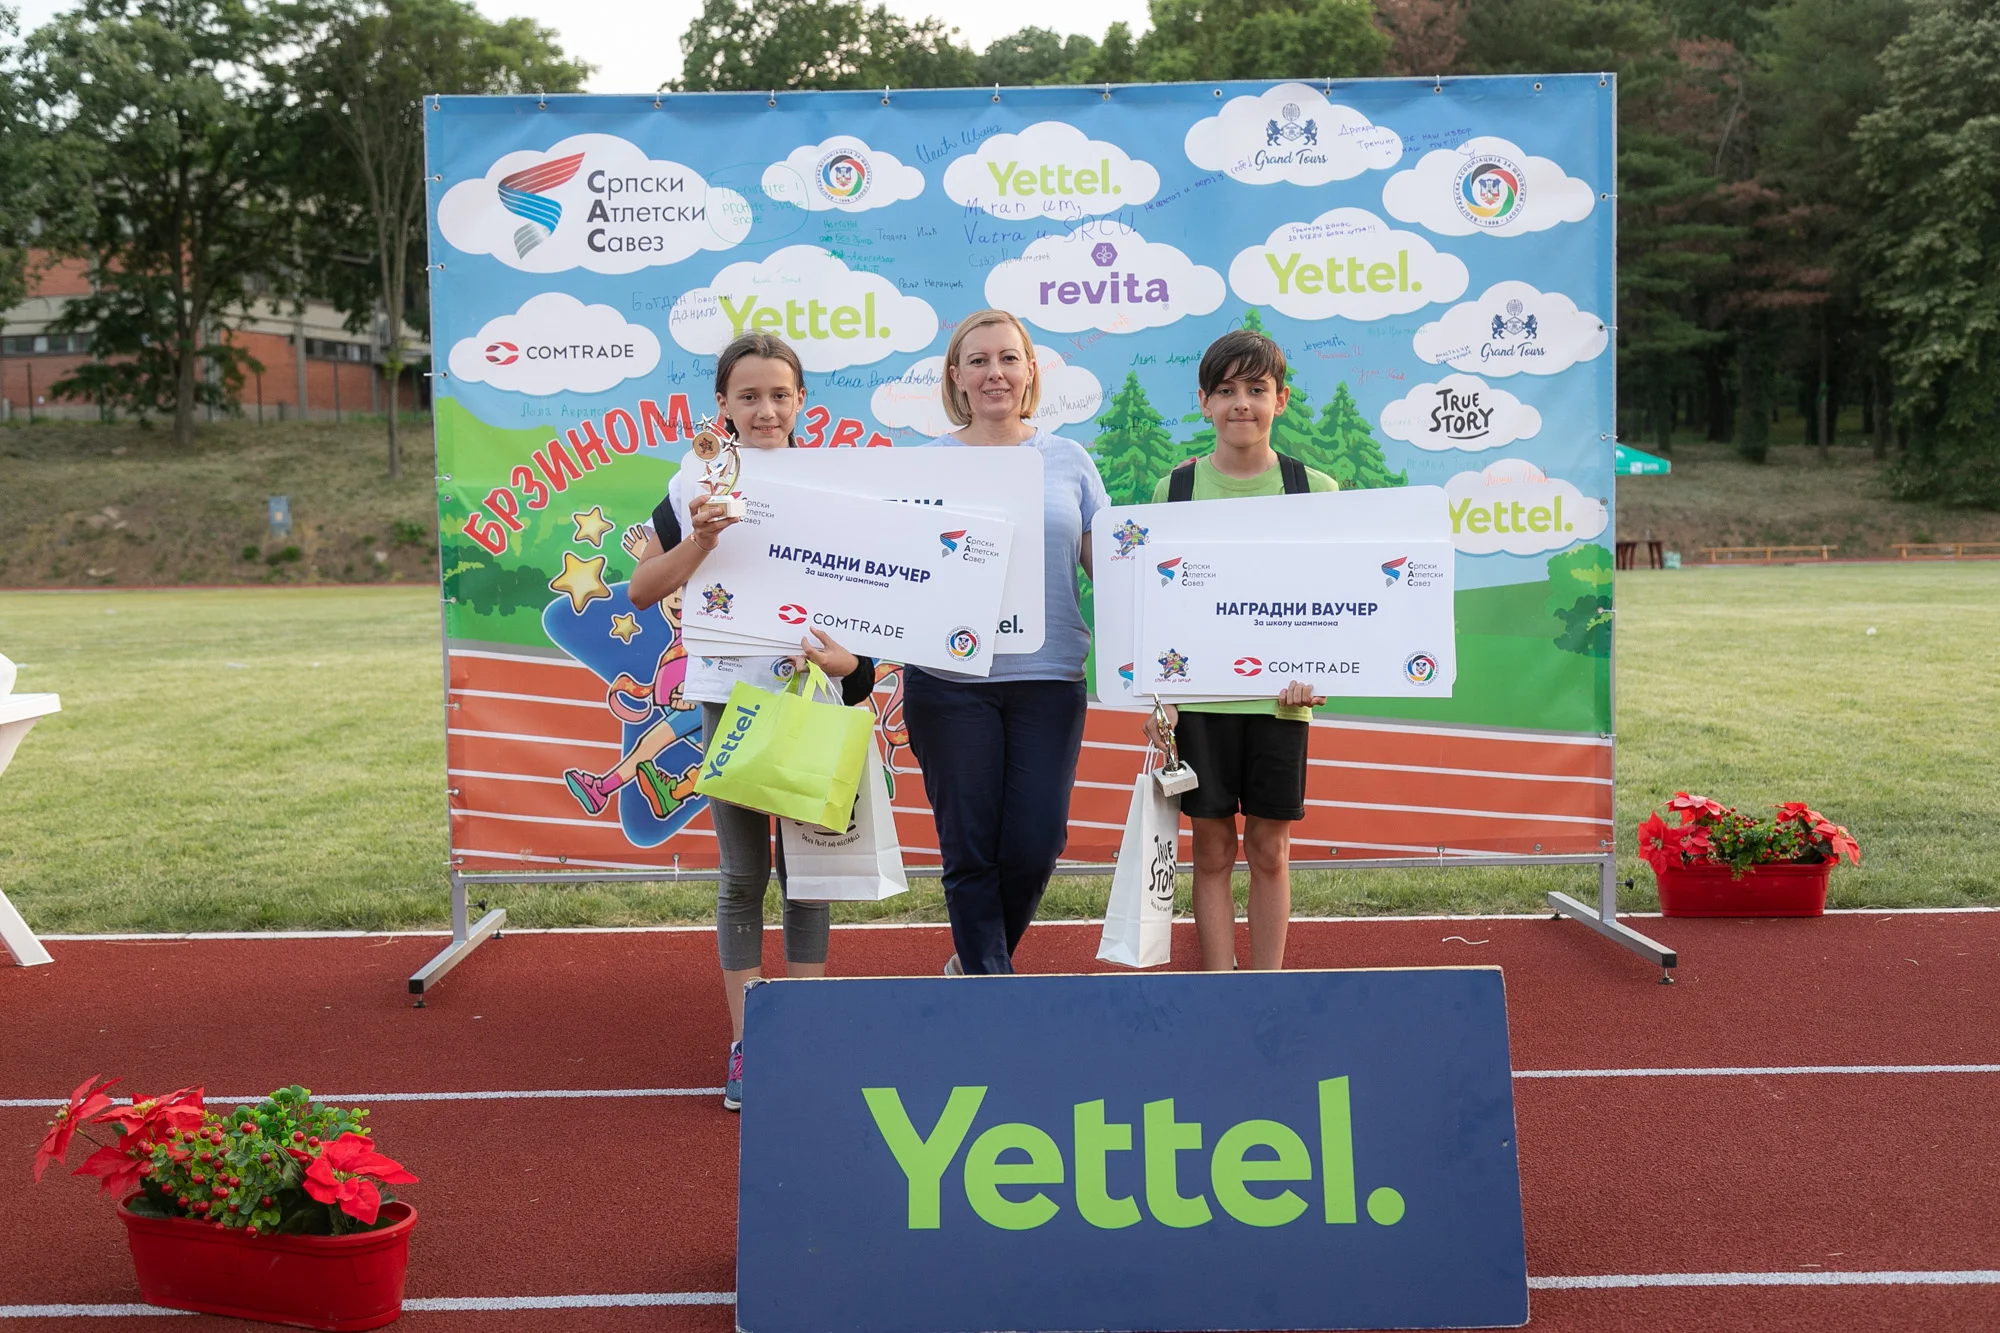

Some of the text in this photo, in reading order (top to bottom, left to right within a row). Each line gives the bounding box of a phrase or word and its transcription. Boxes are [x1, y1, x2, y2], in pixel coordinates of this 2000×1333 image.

[1254, 149, 1328, 171] Grand Tours
[587, 169, 684, 200] Српски
[987, 159, 1121, 197] Yettel.
[587, 198, 706, 224] Атлетски
[587, 228, 664, 253] Савез
[1265, 249, 1422, 294] Yettel.
[1040, 271, 1168, 305] revita
[526, 343, 634, 360] COMTRADE
[1481, 342, 1517, 361] Grand
[1518, 342, 1547, 357] Tours
[1436, 388, 1480, 412] TRUE
[1429, 406, 1494, 434] STORY
[462, 393, 694, 556] БРЗИНОМ
[1449, 495, 1573, 534] Yettel.
[964, 544, 999, 558] Атлетски
[965, 535, 995, 550] Српски
[768, 543, 931, 585] НАГРАДНИ ВАУЧЕР
[963, 552, 986, 565] Савез
[1182, 562, 1210, 572] Српски
[1407, 561, 1437, 572] Српски
[804, 567, 890, 588] За школу шампиона
[1182, 571, 1216, 580] Атлетски
[1182, 579, 1204, 588] Савез
[1407, 570, 1444, 580] Атлетски
[1407, 579, 1431, 588] Савез
[1215, 602, 1378, 618] НАГРАДНИ ВАУЧЕР
[812, 612, 905, 640] COMTRADE
[1253, 619, 1339, 628] За школу шампиона
[1268, 661, 1360, 674] COMTRADE
[703, 703, 761, 781] Yettel.
[1154, 834, 1174, 866] TRUE
[861, 1075, 1405, 1230] Yettel.
